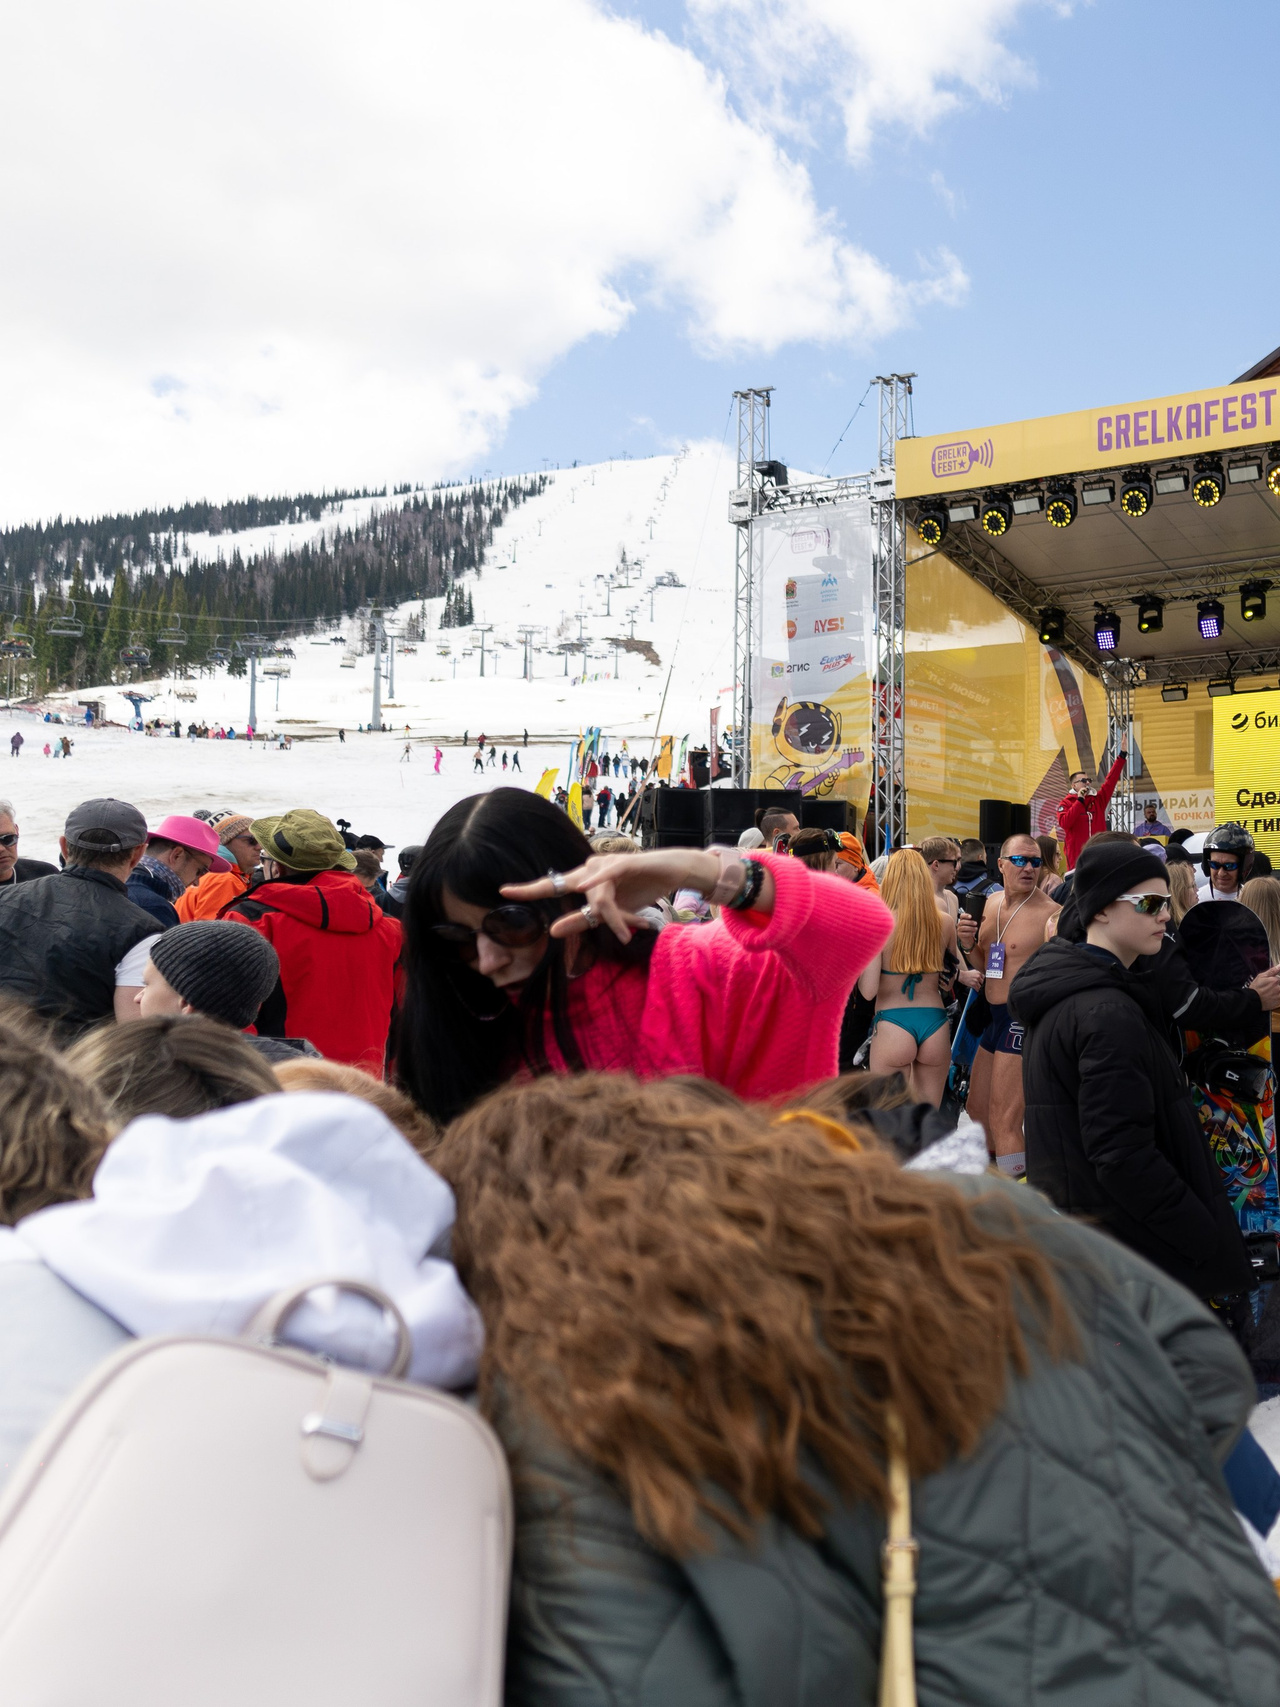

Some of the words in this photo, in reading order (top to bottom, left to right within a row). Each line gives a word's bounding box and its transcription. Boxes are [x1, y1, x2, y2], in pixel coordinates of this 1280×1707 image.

[1097, 388, 1278, 453] GRELKAFEST
[937, 446, 967, 461] GRELKA
[937, 460, 958, 473] FEST
[813, 616, 845, 634] AYS!
[786, 662, 811, 674] 2ГИС
